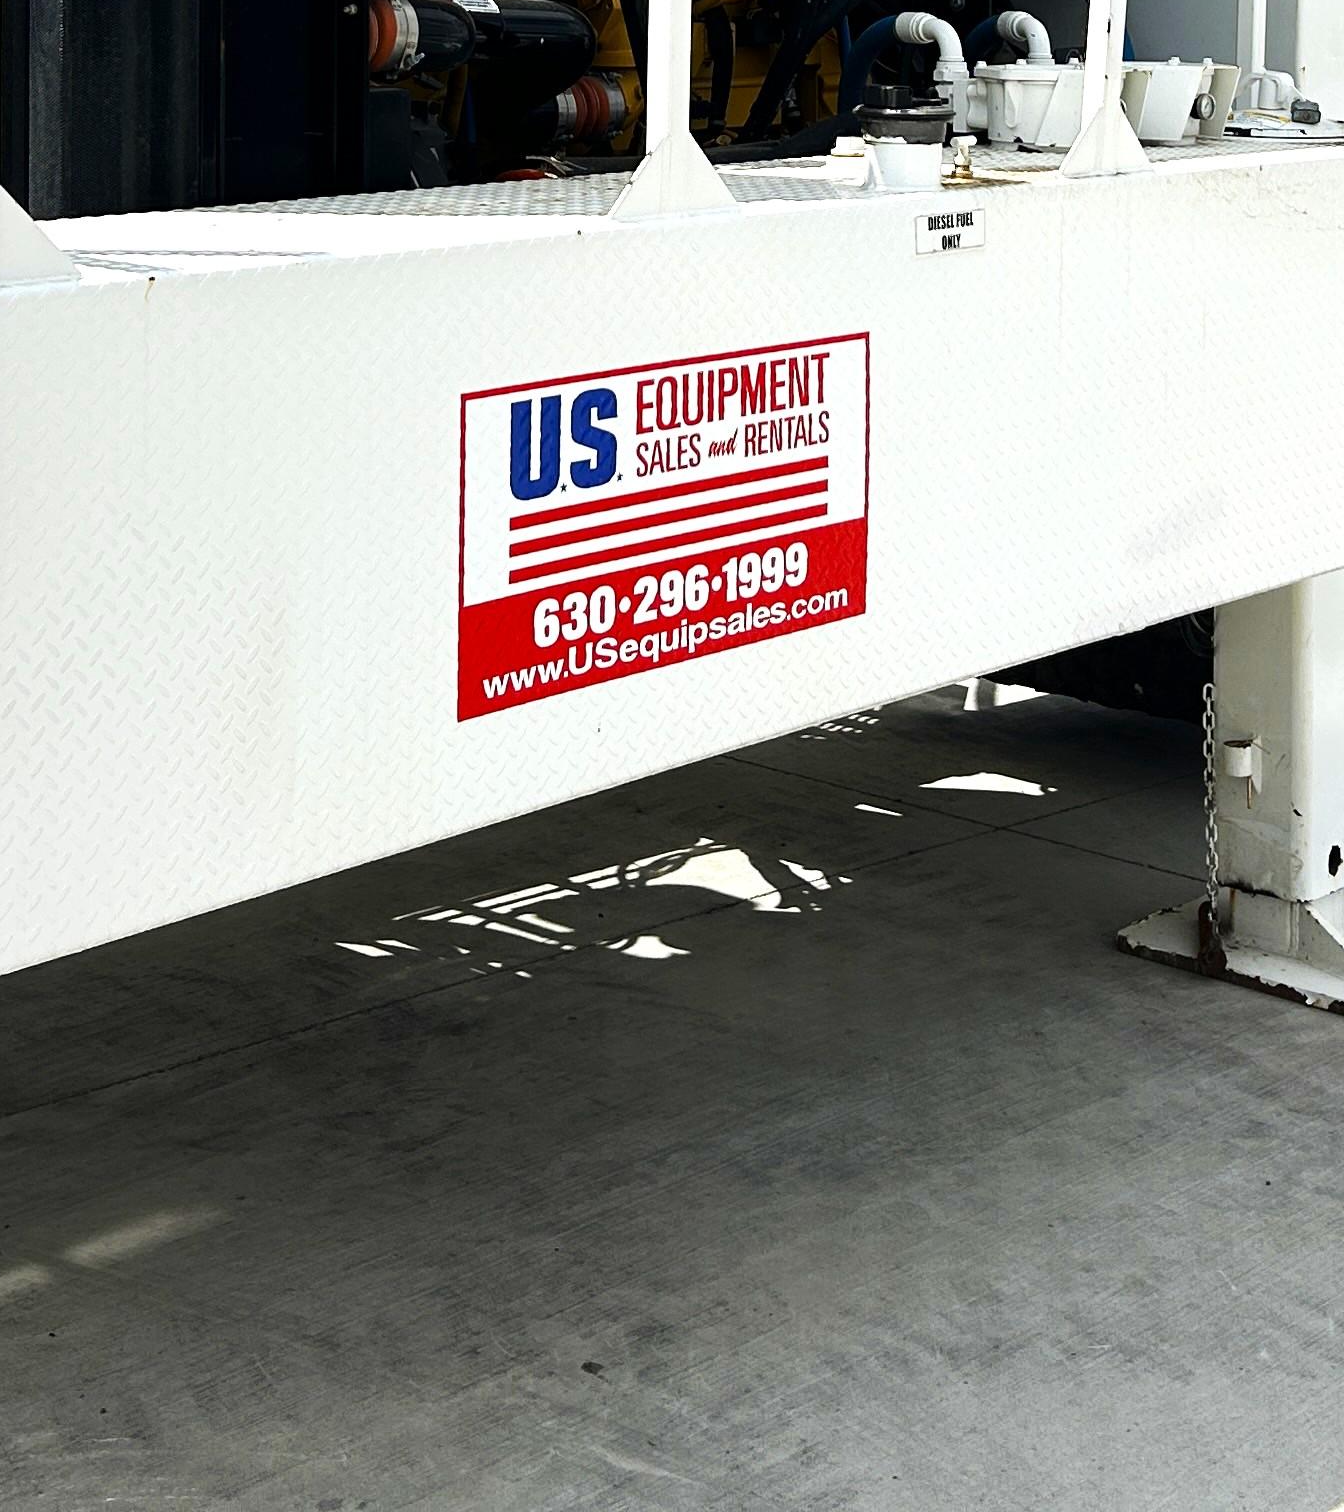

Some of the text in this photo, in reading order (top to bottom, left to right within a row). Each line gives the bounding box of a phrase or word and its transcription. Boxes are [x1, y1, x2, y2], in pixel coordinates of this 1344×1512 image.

[928, 211, 973, 231] DIESEL FUEL
[942, 233, 961, 250] ONLY
[635, 353, 830, 434] EQUIPMENT
[636, 411, 830, 478] SALES and RENTALS
[482, 587, 848, 699] www.USequipsales.com
